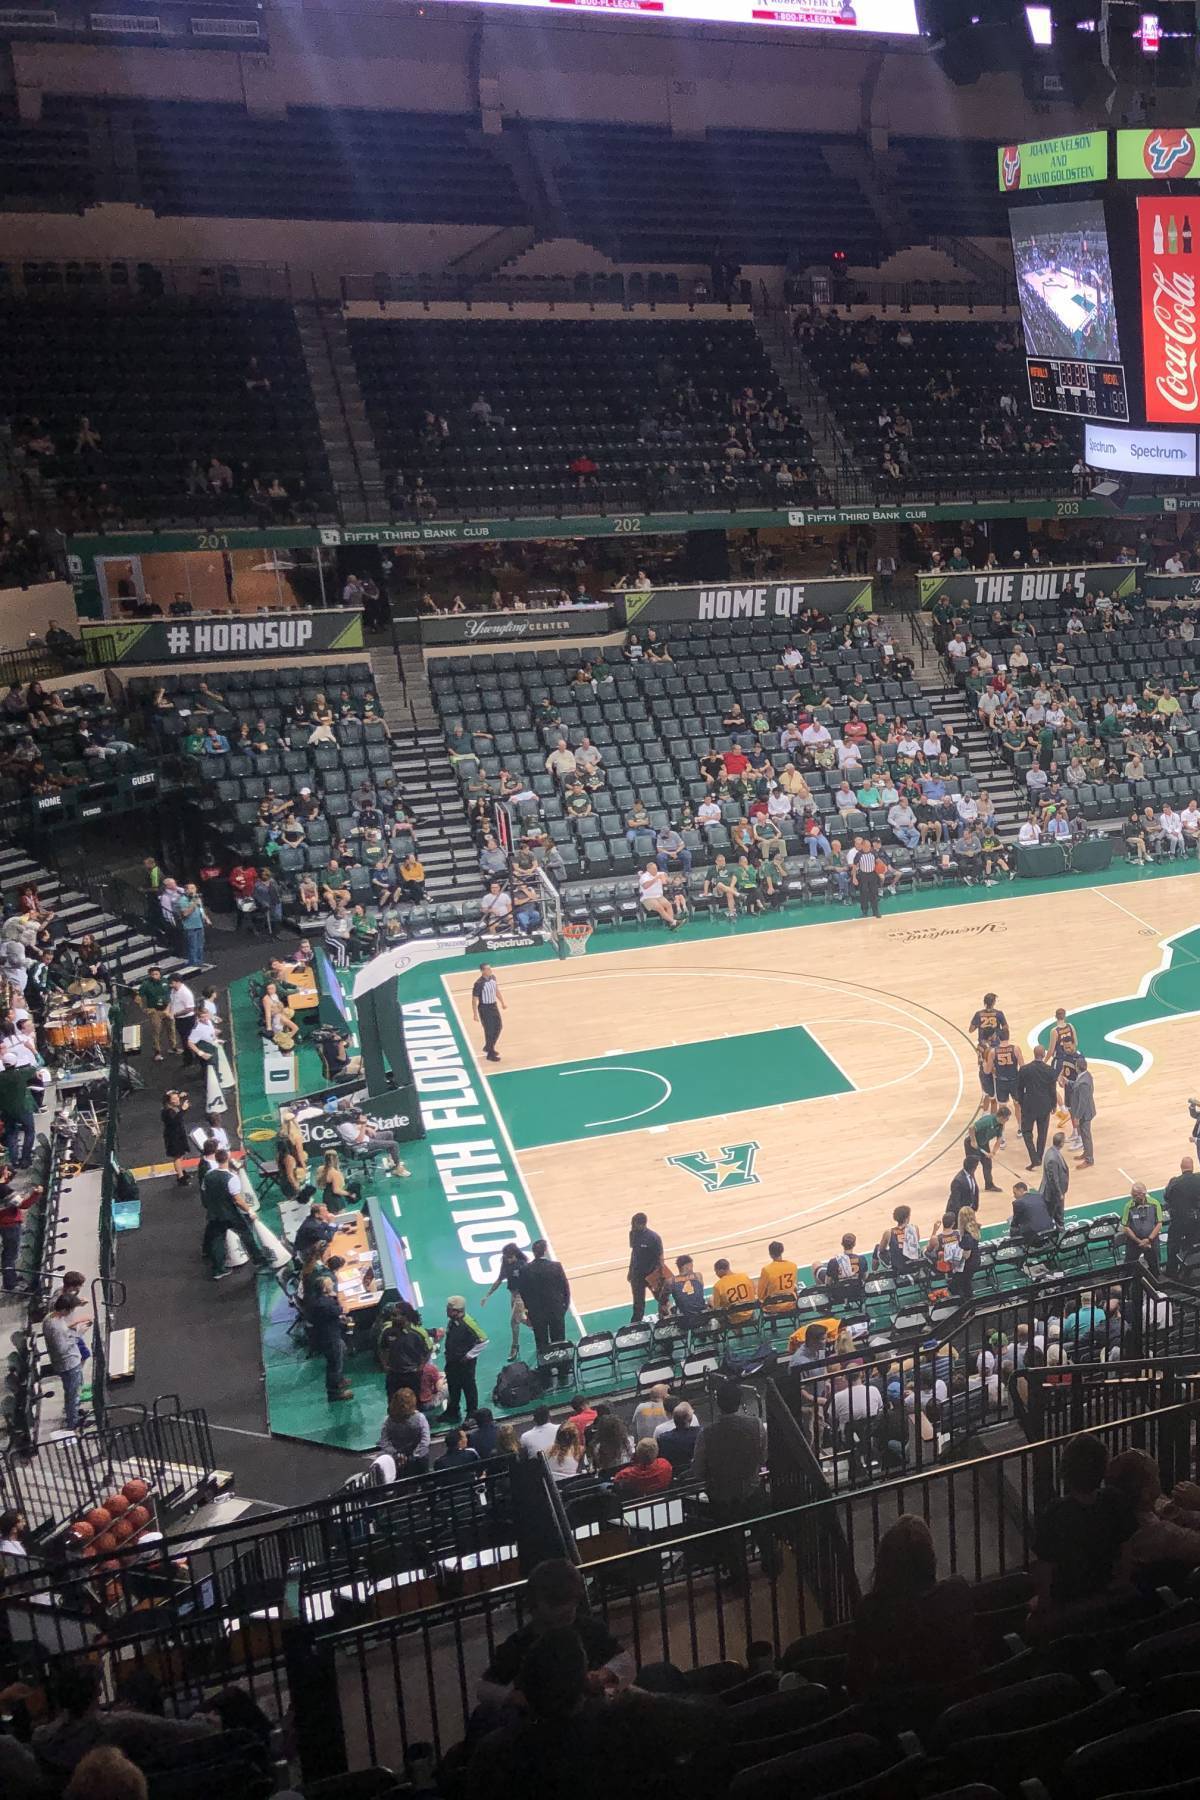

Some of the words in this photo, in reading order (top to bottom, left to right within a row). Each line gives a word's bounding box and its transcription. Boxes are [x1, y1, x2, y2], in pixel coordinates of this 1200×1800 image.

[1029, 140, 1059, 157] JOANNE
[1059, 136, 1091, 152] NELSON
[1051, 154, 1067, 167] AND
[1027, 171, 1050, 185] DAVID
[1050, 166, 1094, 183] GOLDSTEIN
[1089, 439, 1115, 455] Spectrum
[1130, 444, 1183, 460] Spectrum
[807, 513, 836, 522] FIFTH
[839, 512, 870, 521] THIRD
[872, 511, 900, 520] BANK
[905, 510, 927, 519] CLUB
[1056, 503, 1079, 515] 203
[614, 518, 641, 532] 202
[198, 535, 229, 549] 201
[344, 531, 379, 543] FIFTH
[382, 529, 420, 541] THIRD
[424, 528, 457, 539] BANK
[464, 527, 489, 537] CLUB
[975, 574, 1013, 604] THE
[698, 589, 766, 620] HOME
[166, 620, 313, 654] #HORNSUP
[464, 619, 529, 638] Yuengling
[529, 621, 569, 632] CENTER
[39, 796, 62, 809] HOME
[132, 773, 155, 786] GUEST
[486, 938, 534, 951] Spectrum
[401, 998, 487, 1131] FLORIDA
[312, 1114, 410, 1141] CeState
[431, 1138, 533, 1285] SOUTH
[779, 1273, 793, 1291] 13
[726, 1284, 748, 1304] 20
